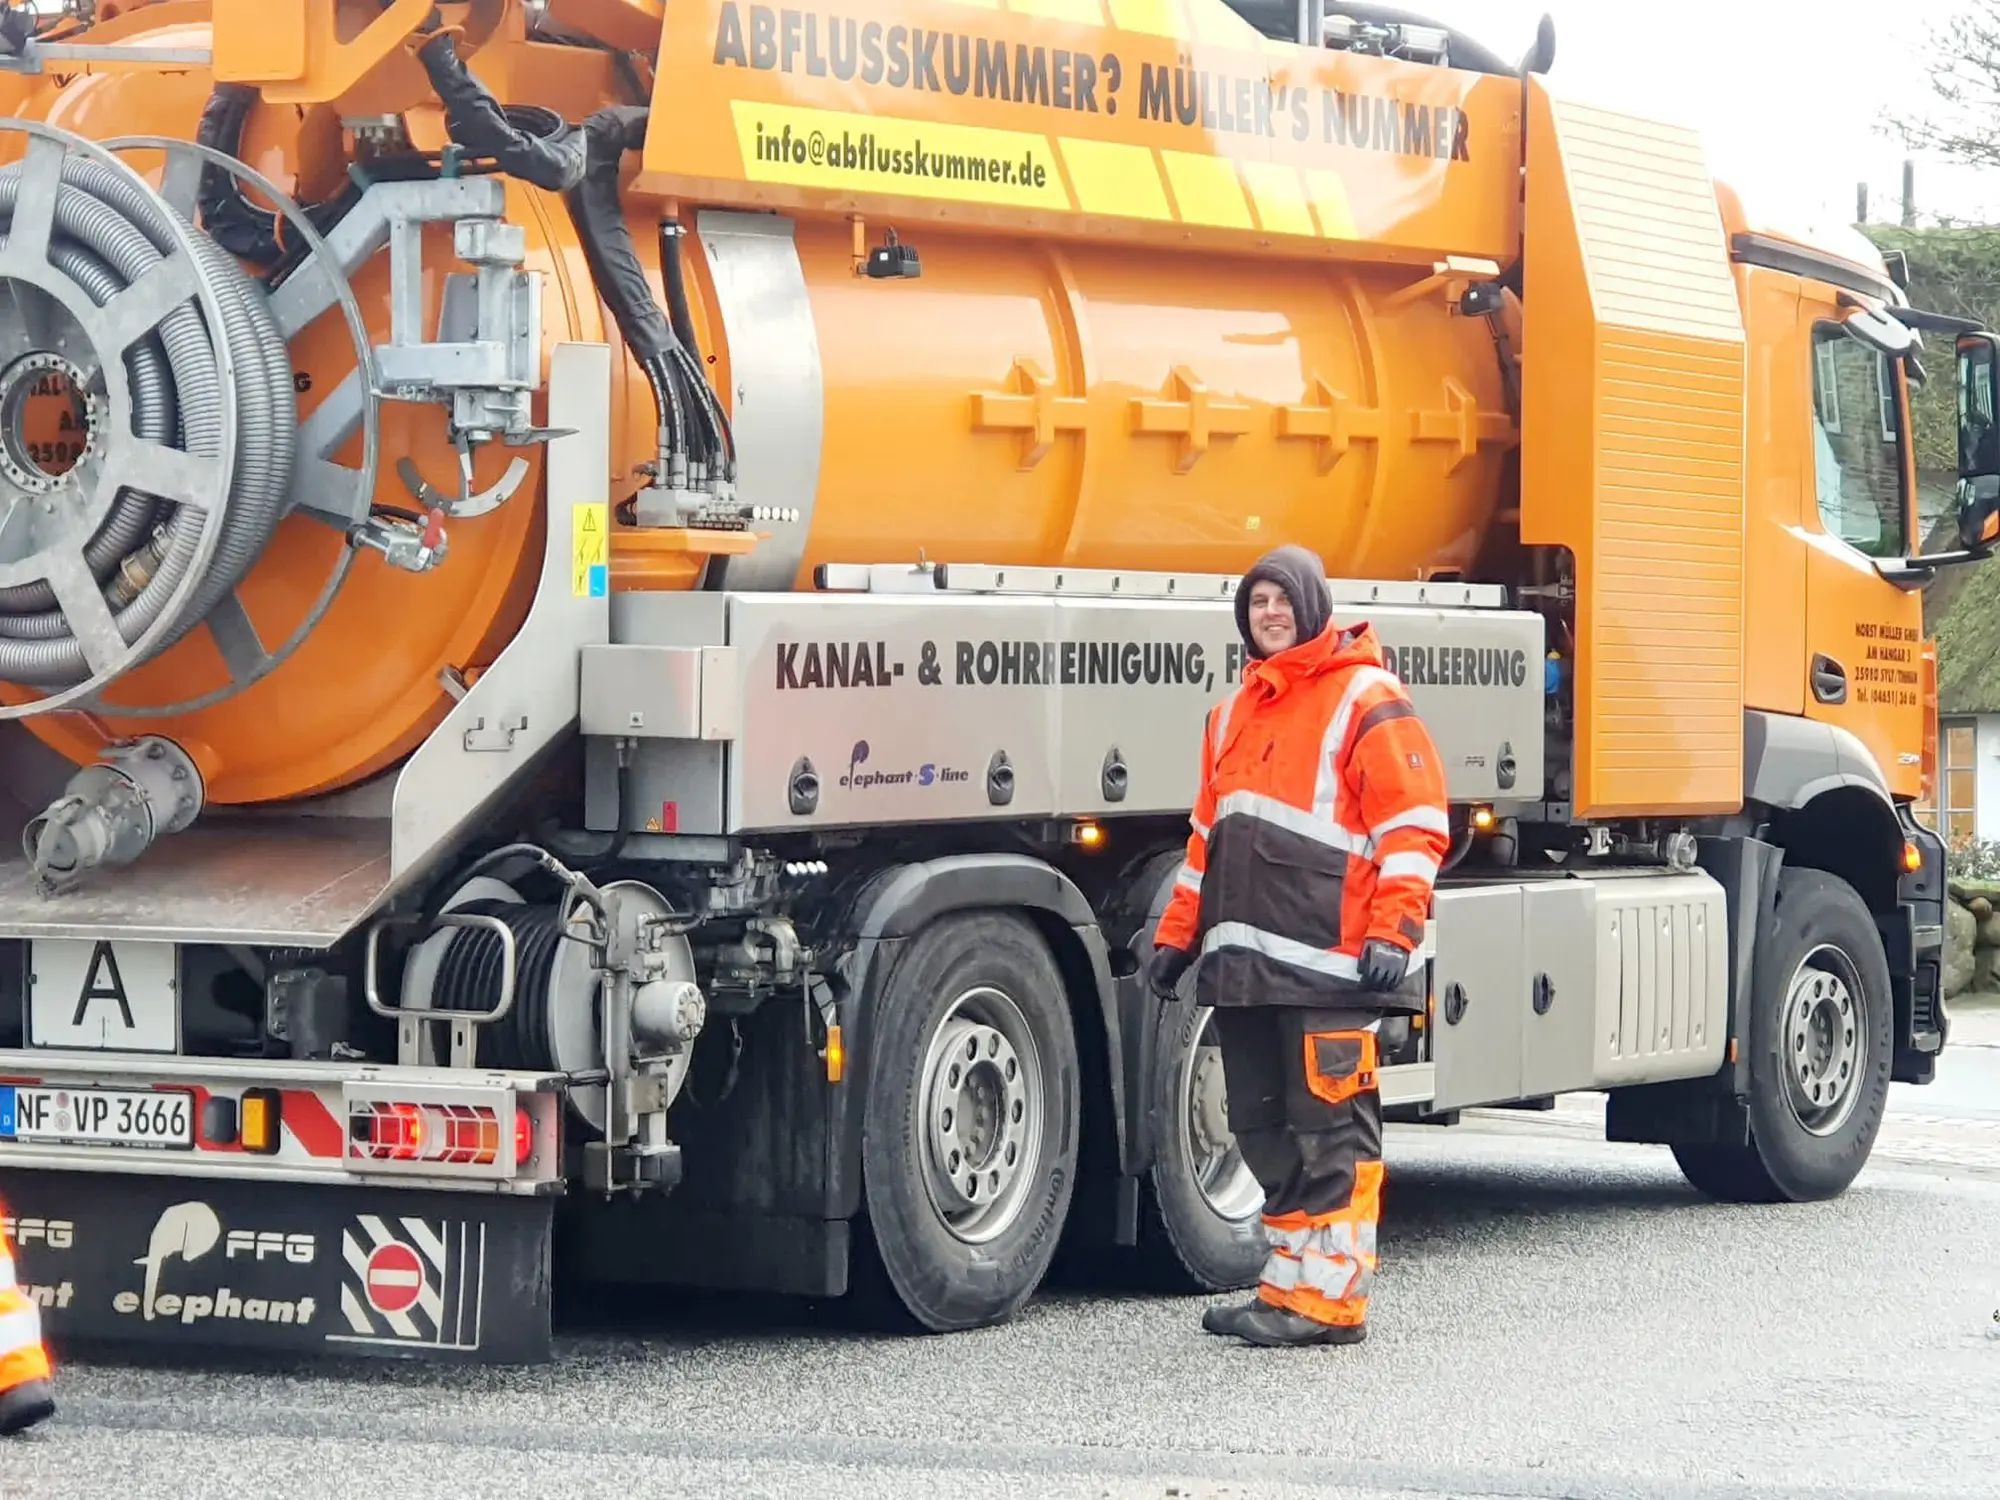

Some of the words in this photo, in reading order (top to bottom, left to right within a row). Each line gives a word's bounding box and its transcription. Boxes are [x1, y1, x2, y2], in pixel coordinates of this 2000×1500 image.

[712, 1, 1121, 115] ABFLUSSKUMMER?
[1323, 89, 1470, 162] NUMMER
[756, 122, 1046, 189] info@abflusskummer.de
[776, 642, 904, 690] KANAL-
[918, 640, 943, 685] &
[956, 641, 1215, 693] ROHRREINIGUNG,
[71, 939, 136, 1029] A
[17, 1094, 51, 1130] NF
[74, 1096, 108, 1133] VP
[117, 1098, 186, 1137] 3666
[226, 1229, 316, 1263] FFG
